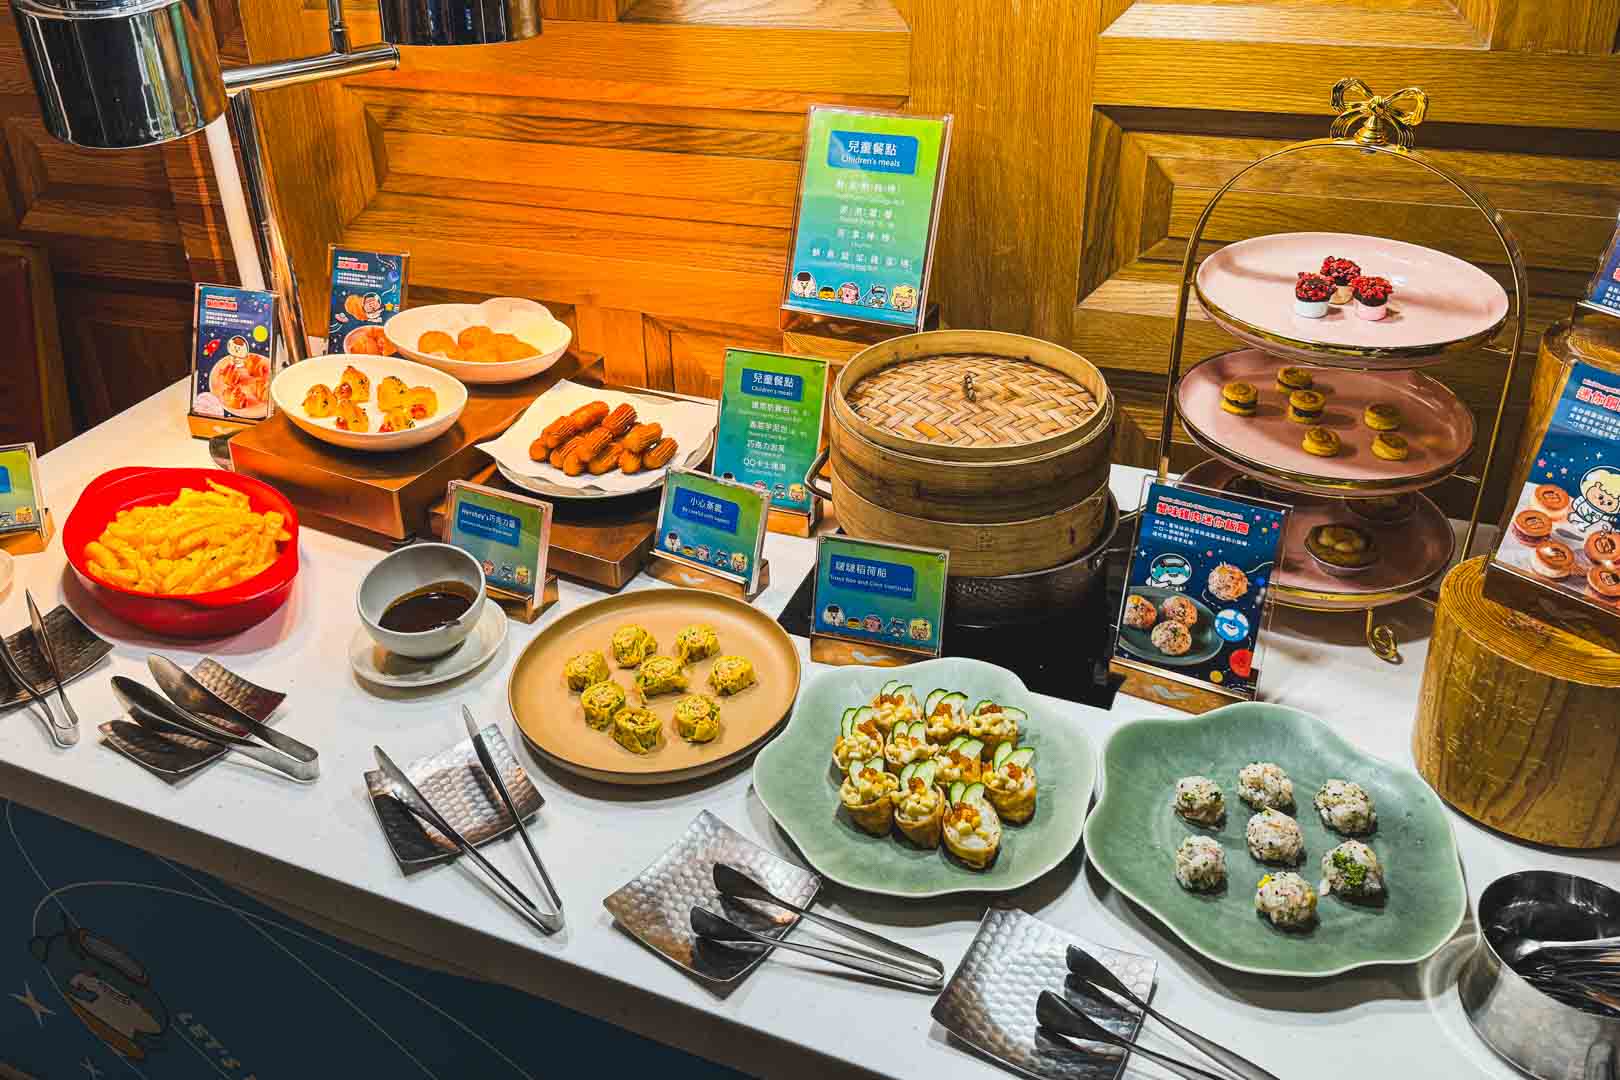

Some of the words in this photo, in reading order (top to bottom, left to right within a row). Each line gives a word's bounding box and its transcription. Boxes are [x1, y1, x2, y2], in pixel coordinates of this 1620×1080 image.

[848, 140, 897, 156] 兒童餐點
[879, 158, 900, 168] meals
[752, 372, 794, 388] 兒童餐點
